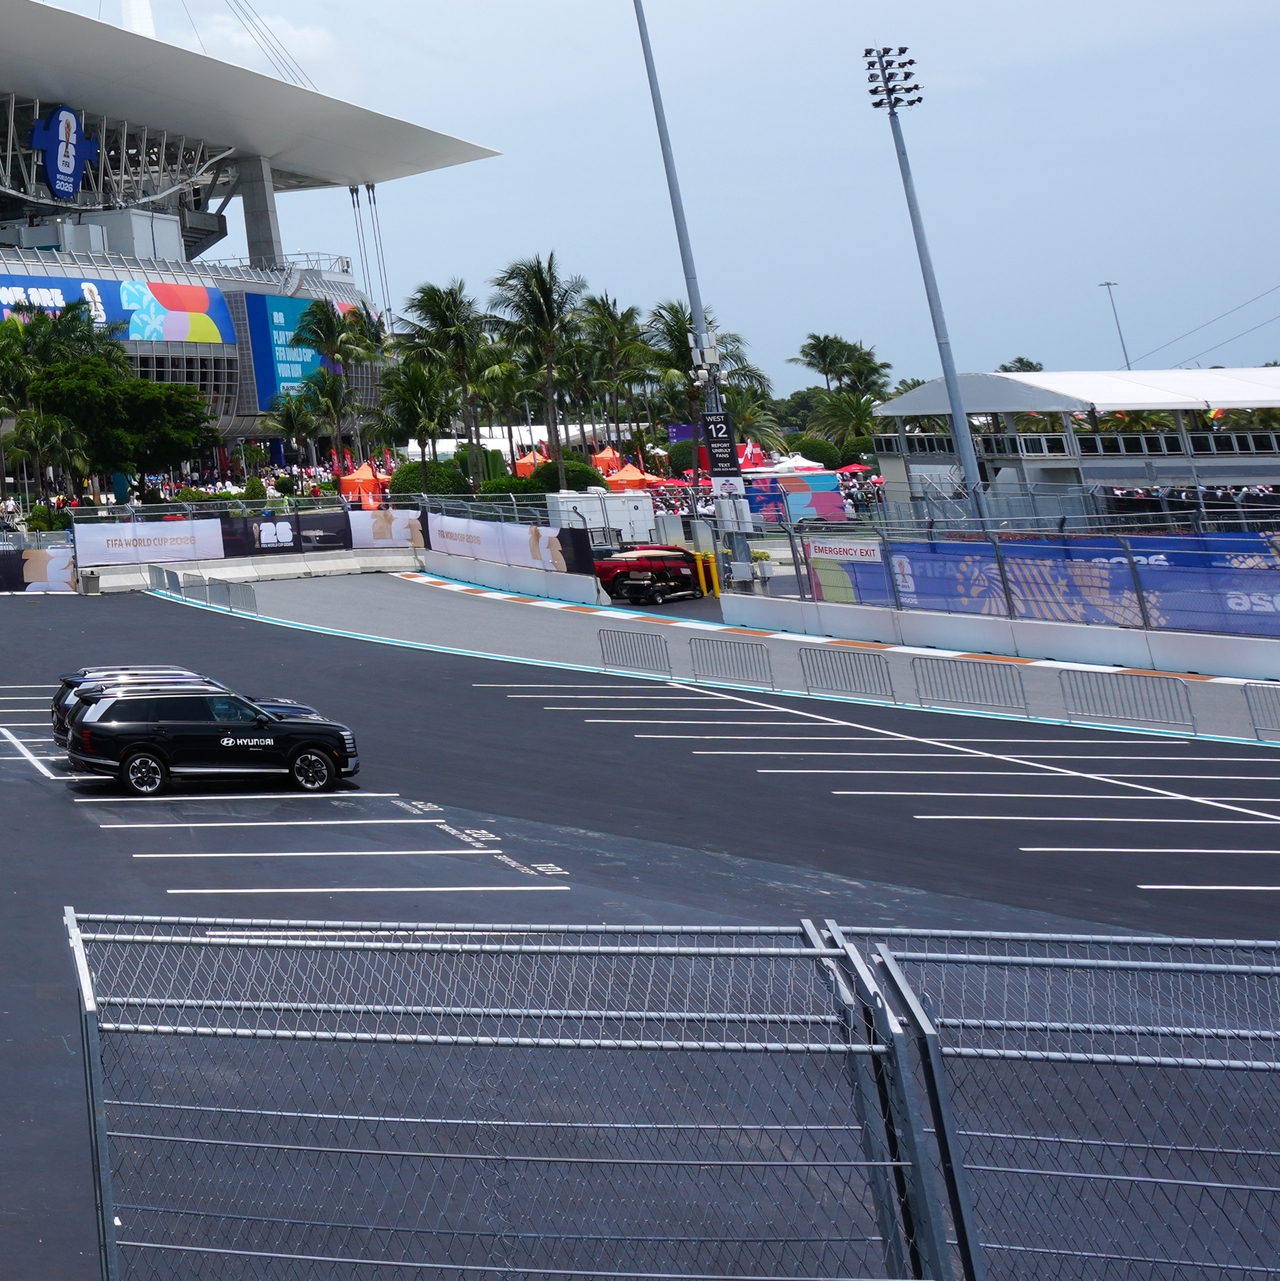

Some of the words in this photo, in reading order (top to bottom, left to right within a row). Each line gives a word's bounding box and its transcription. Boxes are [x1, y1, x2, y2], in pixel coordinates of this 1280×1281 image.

[56, 180, 73, 193] 2026
[275, 347, 286, 361] FIFA
[708, 423, 728, 438] 12
[106, 538, 123, 548] FIFA
[124, 538, 151, 547] WORLD
[153, 537, 168, 546] CUP
[169, 536, 196, 546] 2026
[814, 545, 858, 556] EMERGENCY
[860, 548, 876, 557] EXIT
[236, 738, 274, 746] HYUNDAI
